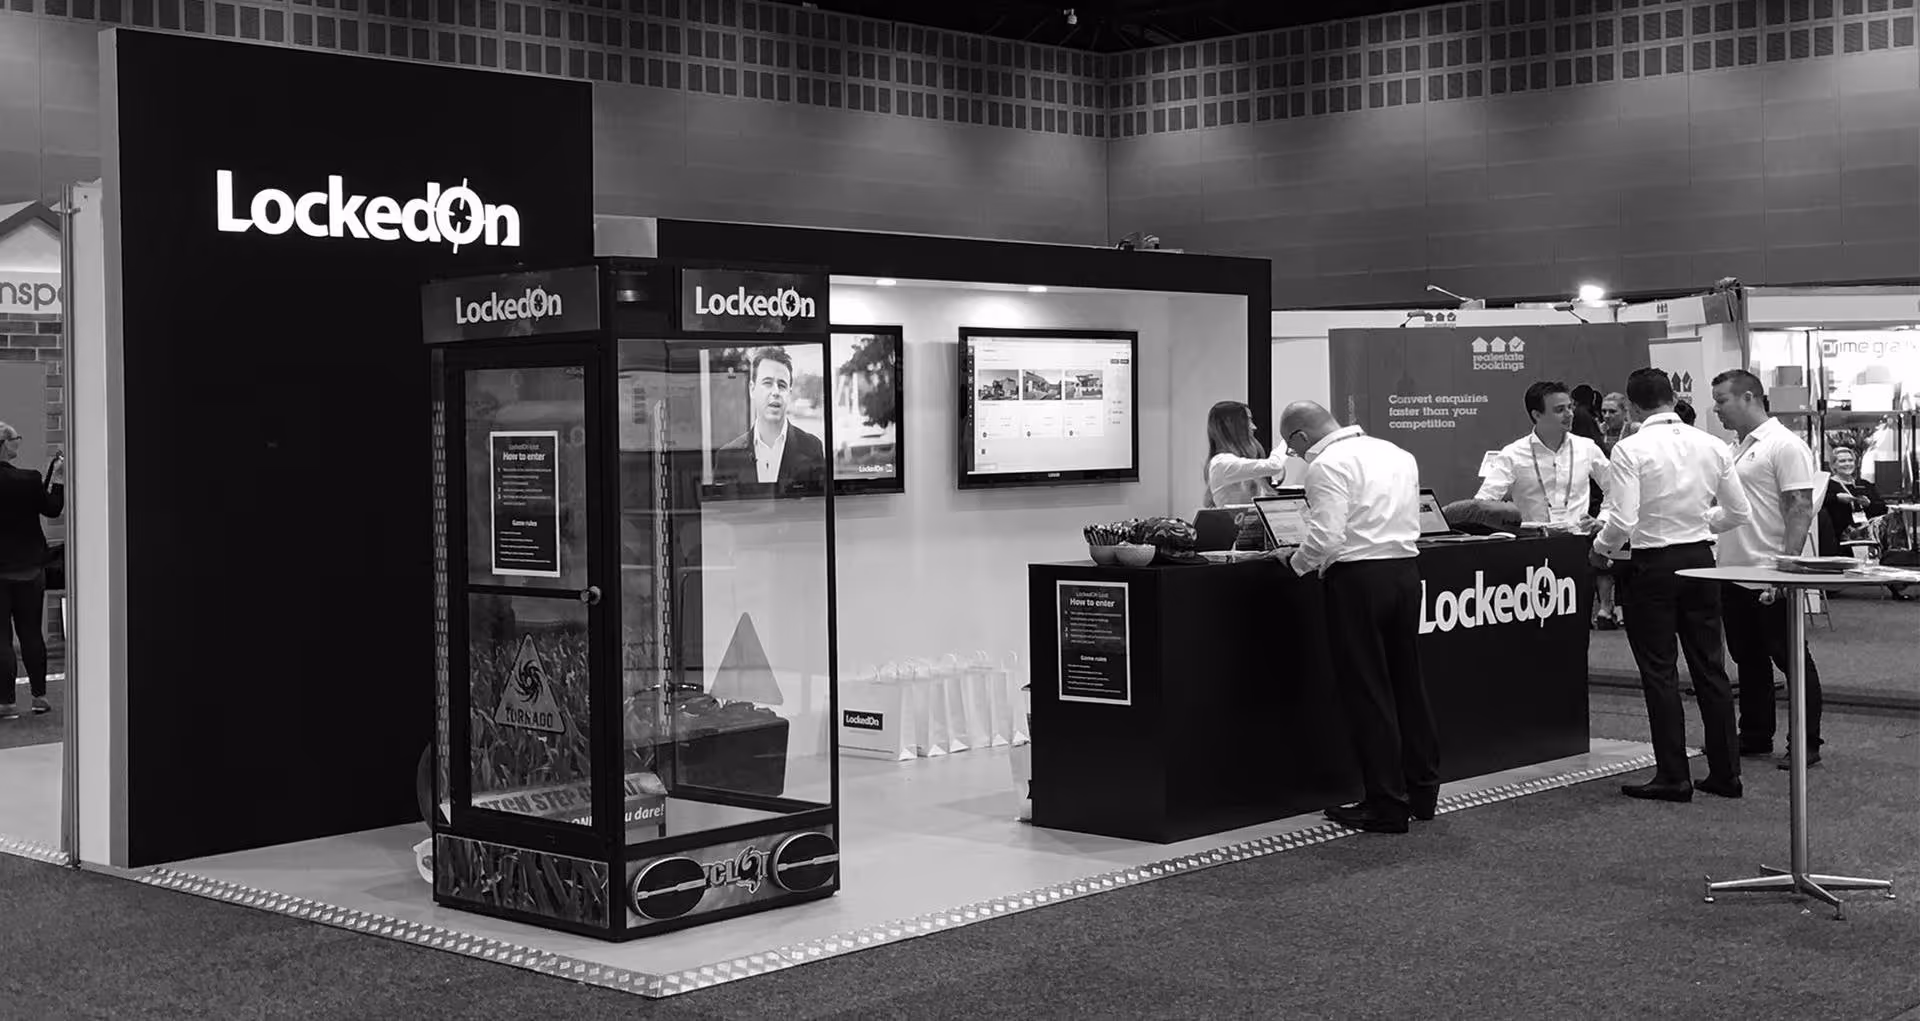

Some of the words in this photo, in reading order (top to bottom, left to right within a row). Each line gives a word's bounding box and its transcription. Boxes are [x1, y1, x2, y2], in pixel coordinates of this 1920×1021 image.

[216, 169, 521, 255] LockedOn
[0, 282, 62, 312] nsp
[695, 285, 816, 322] LockedOn
[455, 286, 562, 325] LockedOn
[1472, 352, 1525, 361] realestate
[1472, 361, 1525, 371] bookings
[1388, 394, 1432, 404] Convert
[1435, 394, 1488, 406] enquiries
[1388, 407, 1420, 417] faster
[1422, 406, 1449, 416] than
[1452, 408, 1478, 418] your
[1388, 419, 1456, 430] competition
[502, 452, 518, 461] How
[519, 452, 526, 461] to
[527, 453, 546, 461] enter
[1069, 598, 1086, 606] How
[1086, 599, 1094, 607] to
[1095, 599, 1116, 608] enter
[1418, 559, 1577, 635] LockedOn
[504, 706, 554, 728] TORNADO
[845, 713, 880, 727] LockedOn
[634, 803, 665, 821] dare!
